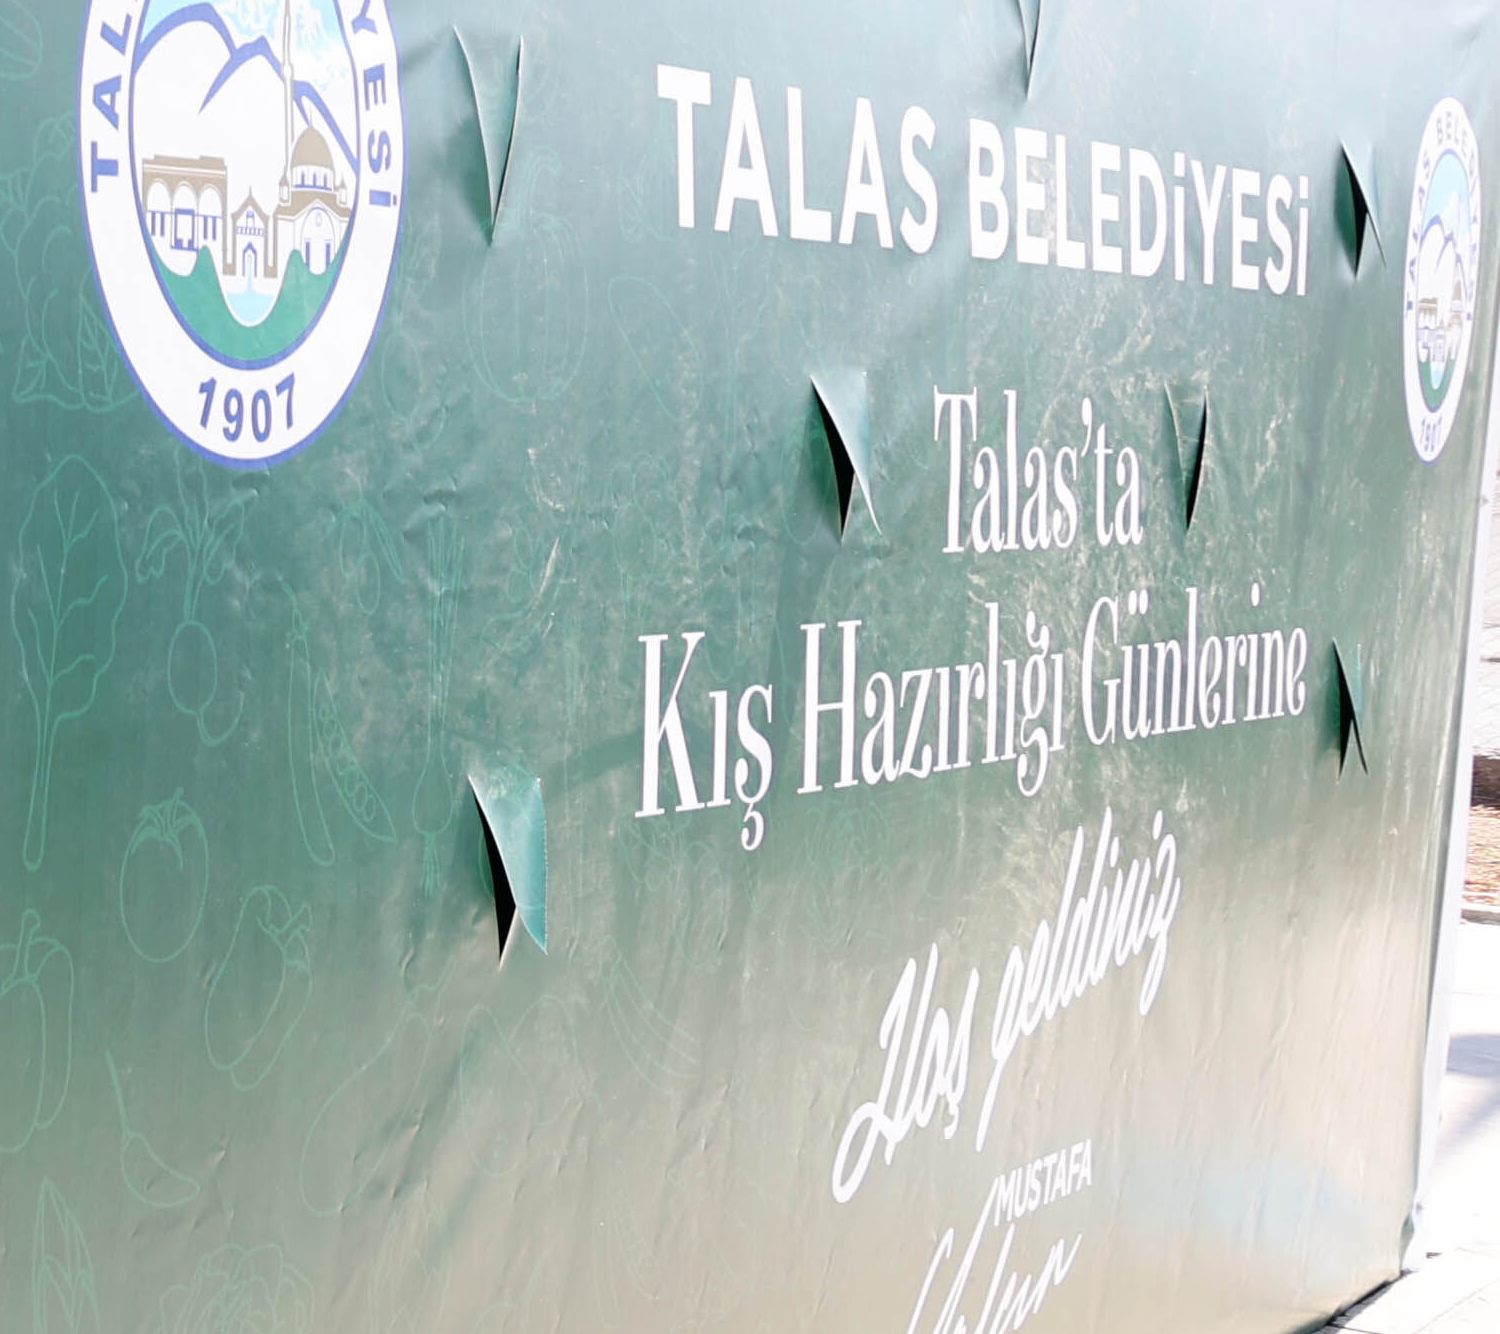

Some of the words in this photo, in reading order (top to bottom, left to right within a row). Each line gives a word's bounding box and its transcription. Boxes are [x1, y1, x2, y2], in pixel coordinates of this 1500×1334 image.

[657, 63, 940, 255] TALAS
[968, 117, 1312, 298] BELEDİYESİ
[198, 371, 296, 444] 1907
[932, 383, 1145, 556] Talas'ta
[634, 629, 775, 853] Kış
[796, 601, 1066, 799] Hazırlığı
[1081, 581, 1310, 749] Günlerine
[831, 941, 980, 1205] Hoş
[975, 806, 1182, 1153] geldiniz
[992, 1137, 1094, 1228] MUSTAFA
